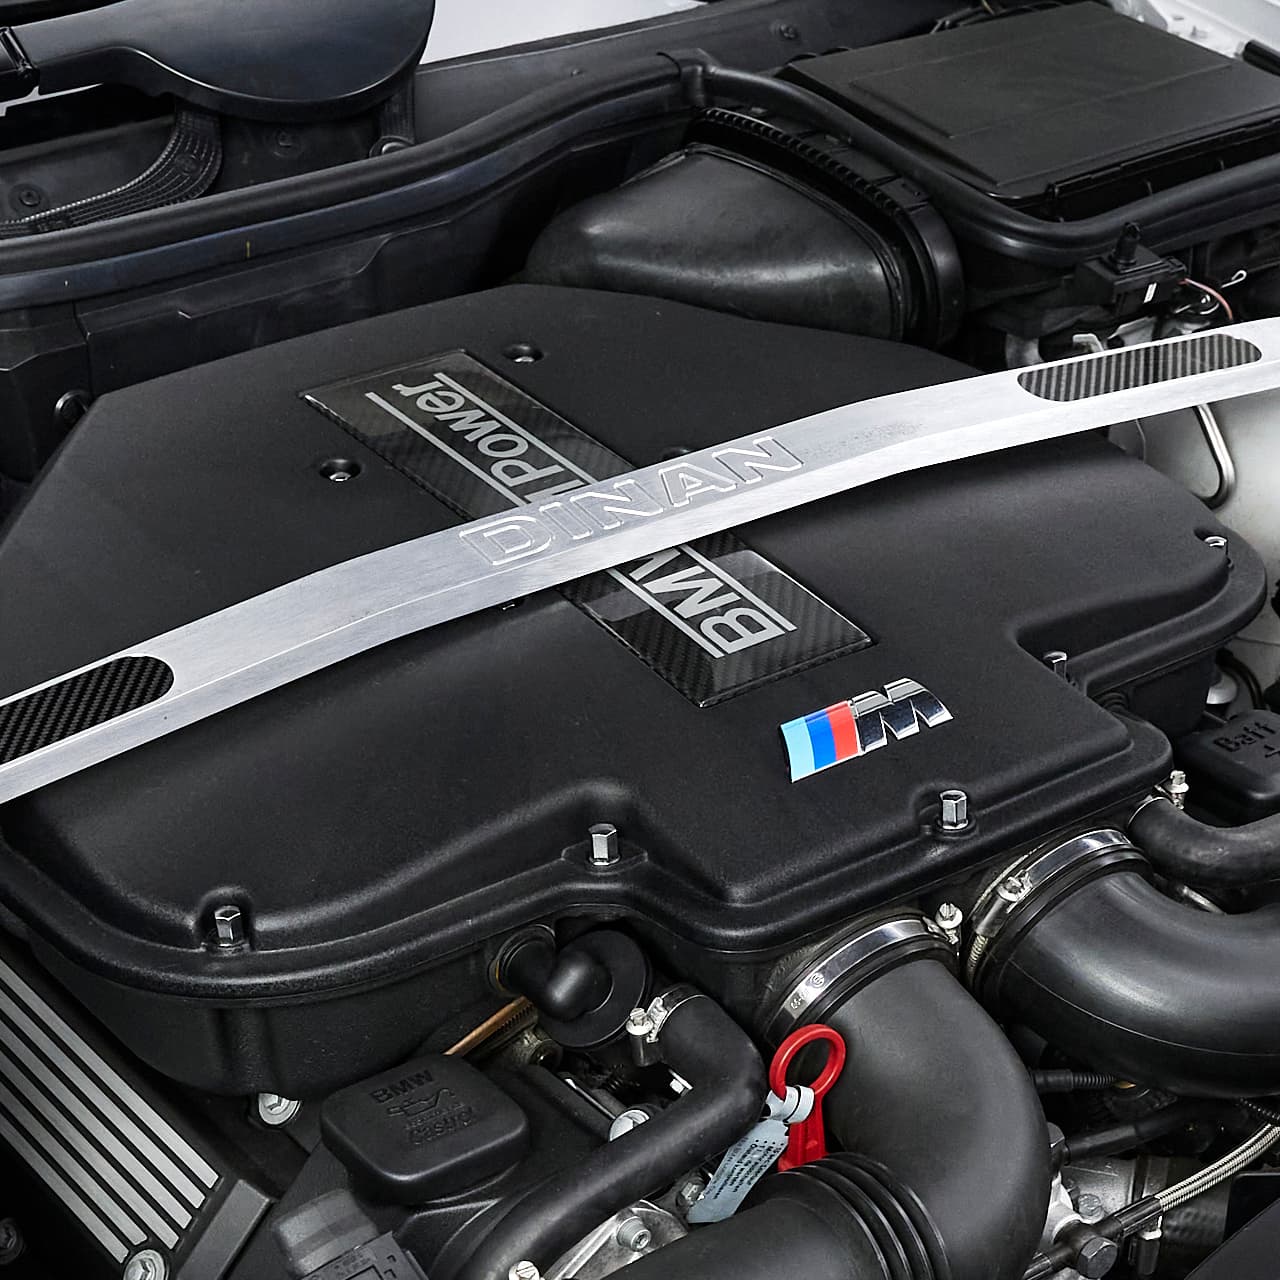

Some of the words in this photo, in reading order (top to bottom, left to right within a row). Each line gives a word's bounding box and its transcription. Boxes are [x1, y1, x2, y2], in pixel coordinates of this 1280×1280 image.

[392, 378, 565, 488] Power
[459, 435, 804, 566] DINAN
[371, 1069, 435, 1104] BMW
